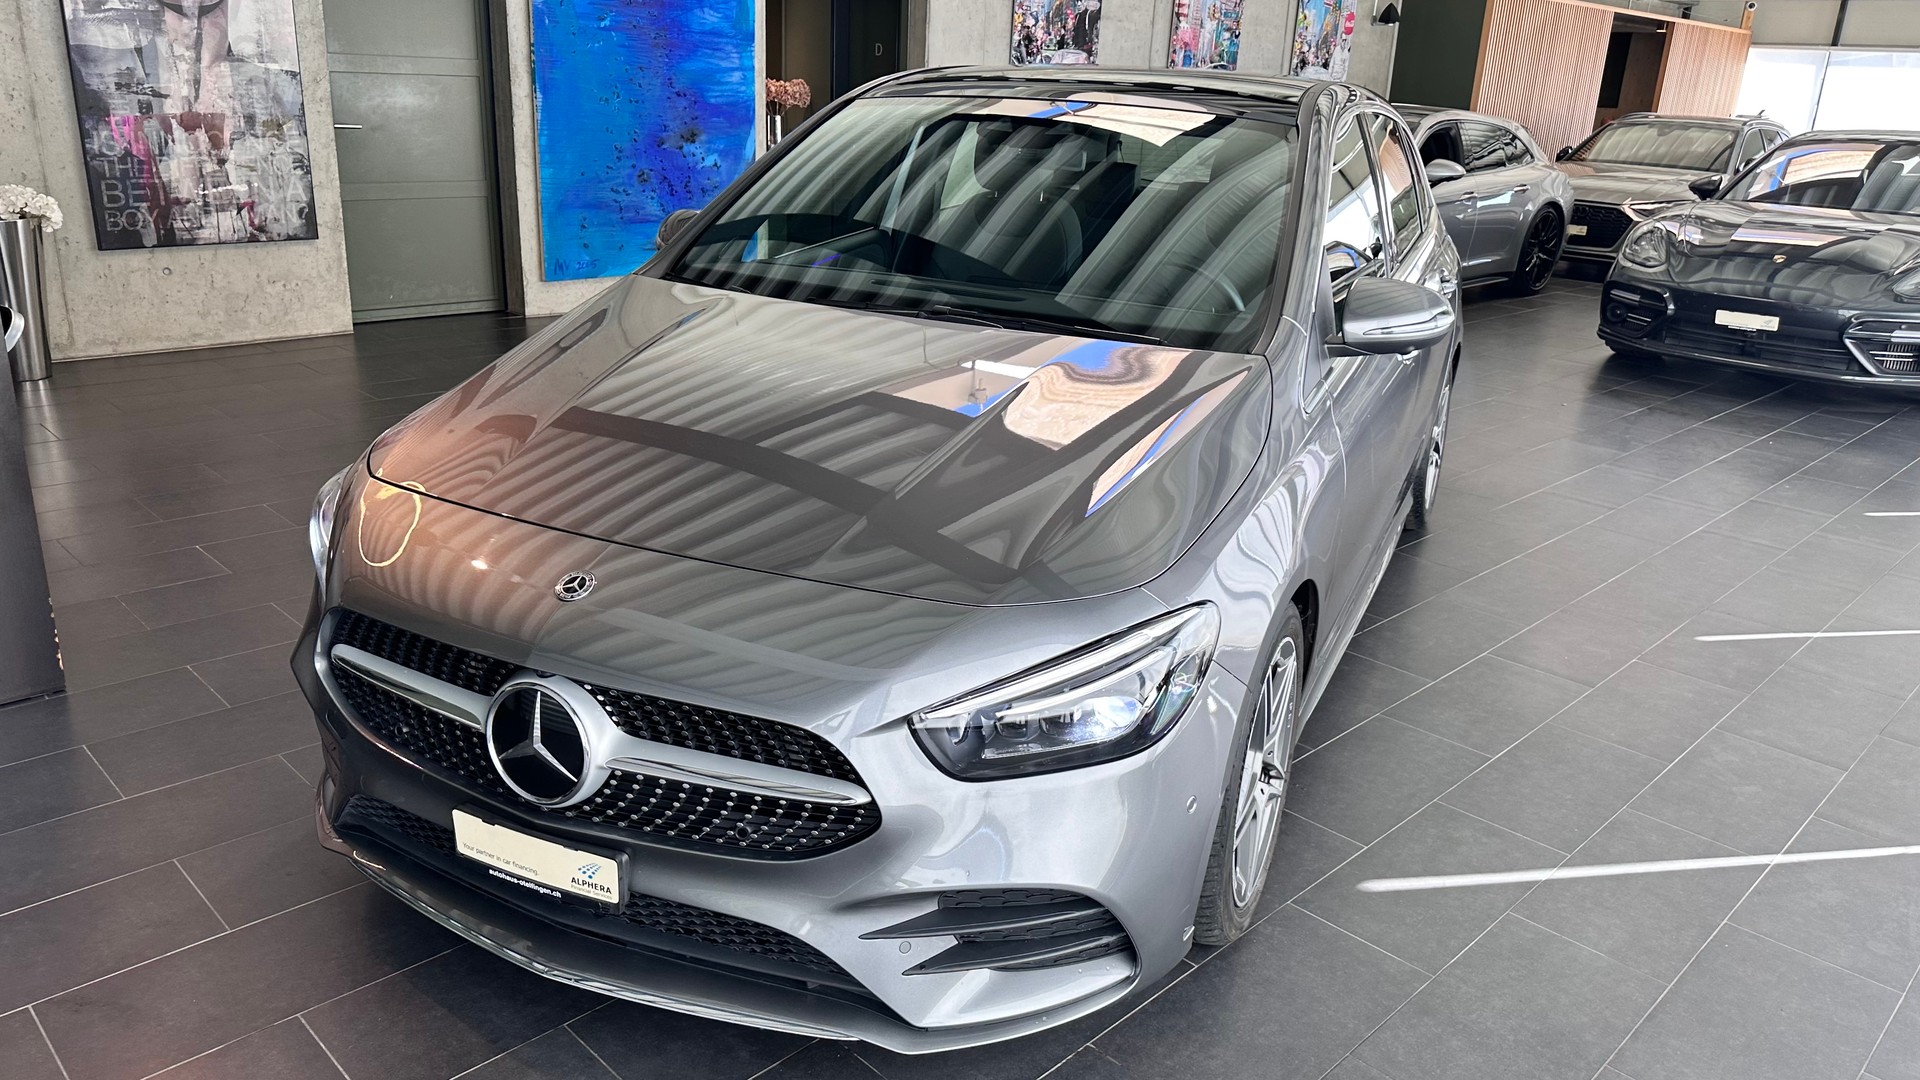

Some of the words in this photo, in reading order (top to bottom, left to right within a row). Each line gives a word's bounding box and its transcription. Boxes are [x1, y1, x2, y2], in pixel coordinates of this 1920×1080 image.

[462, 842, 475, 851] Your
[475, 847, 495, 859] partner
[496, 854, 502, 862] in
[571, 876, 612, 895] ALPHERA
